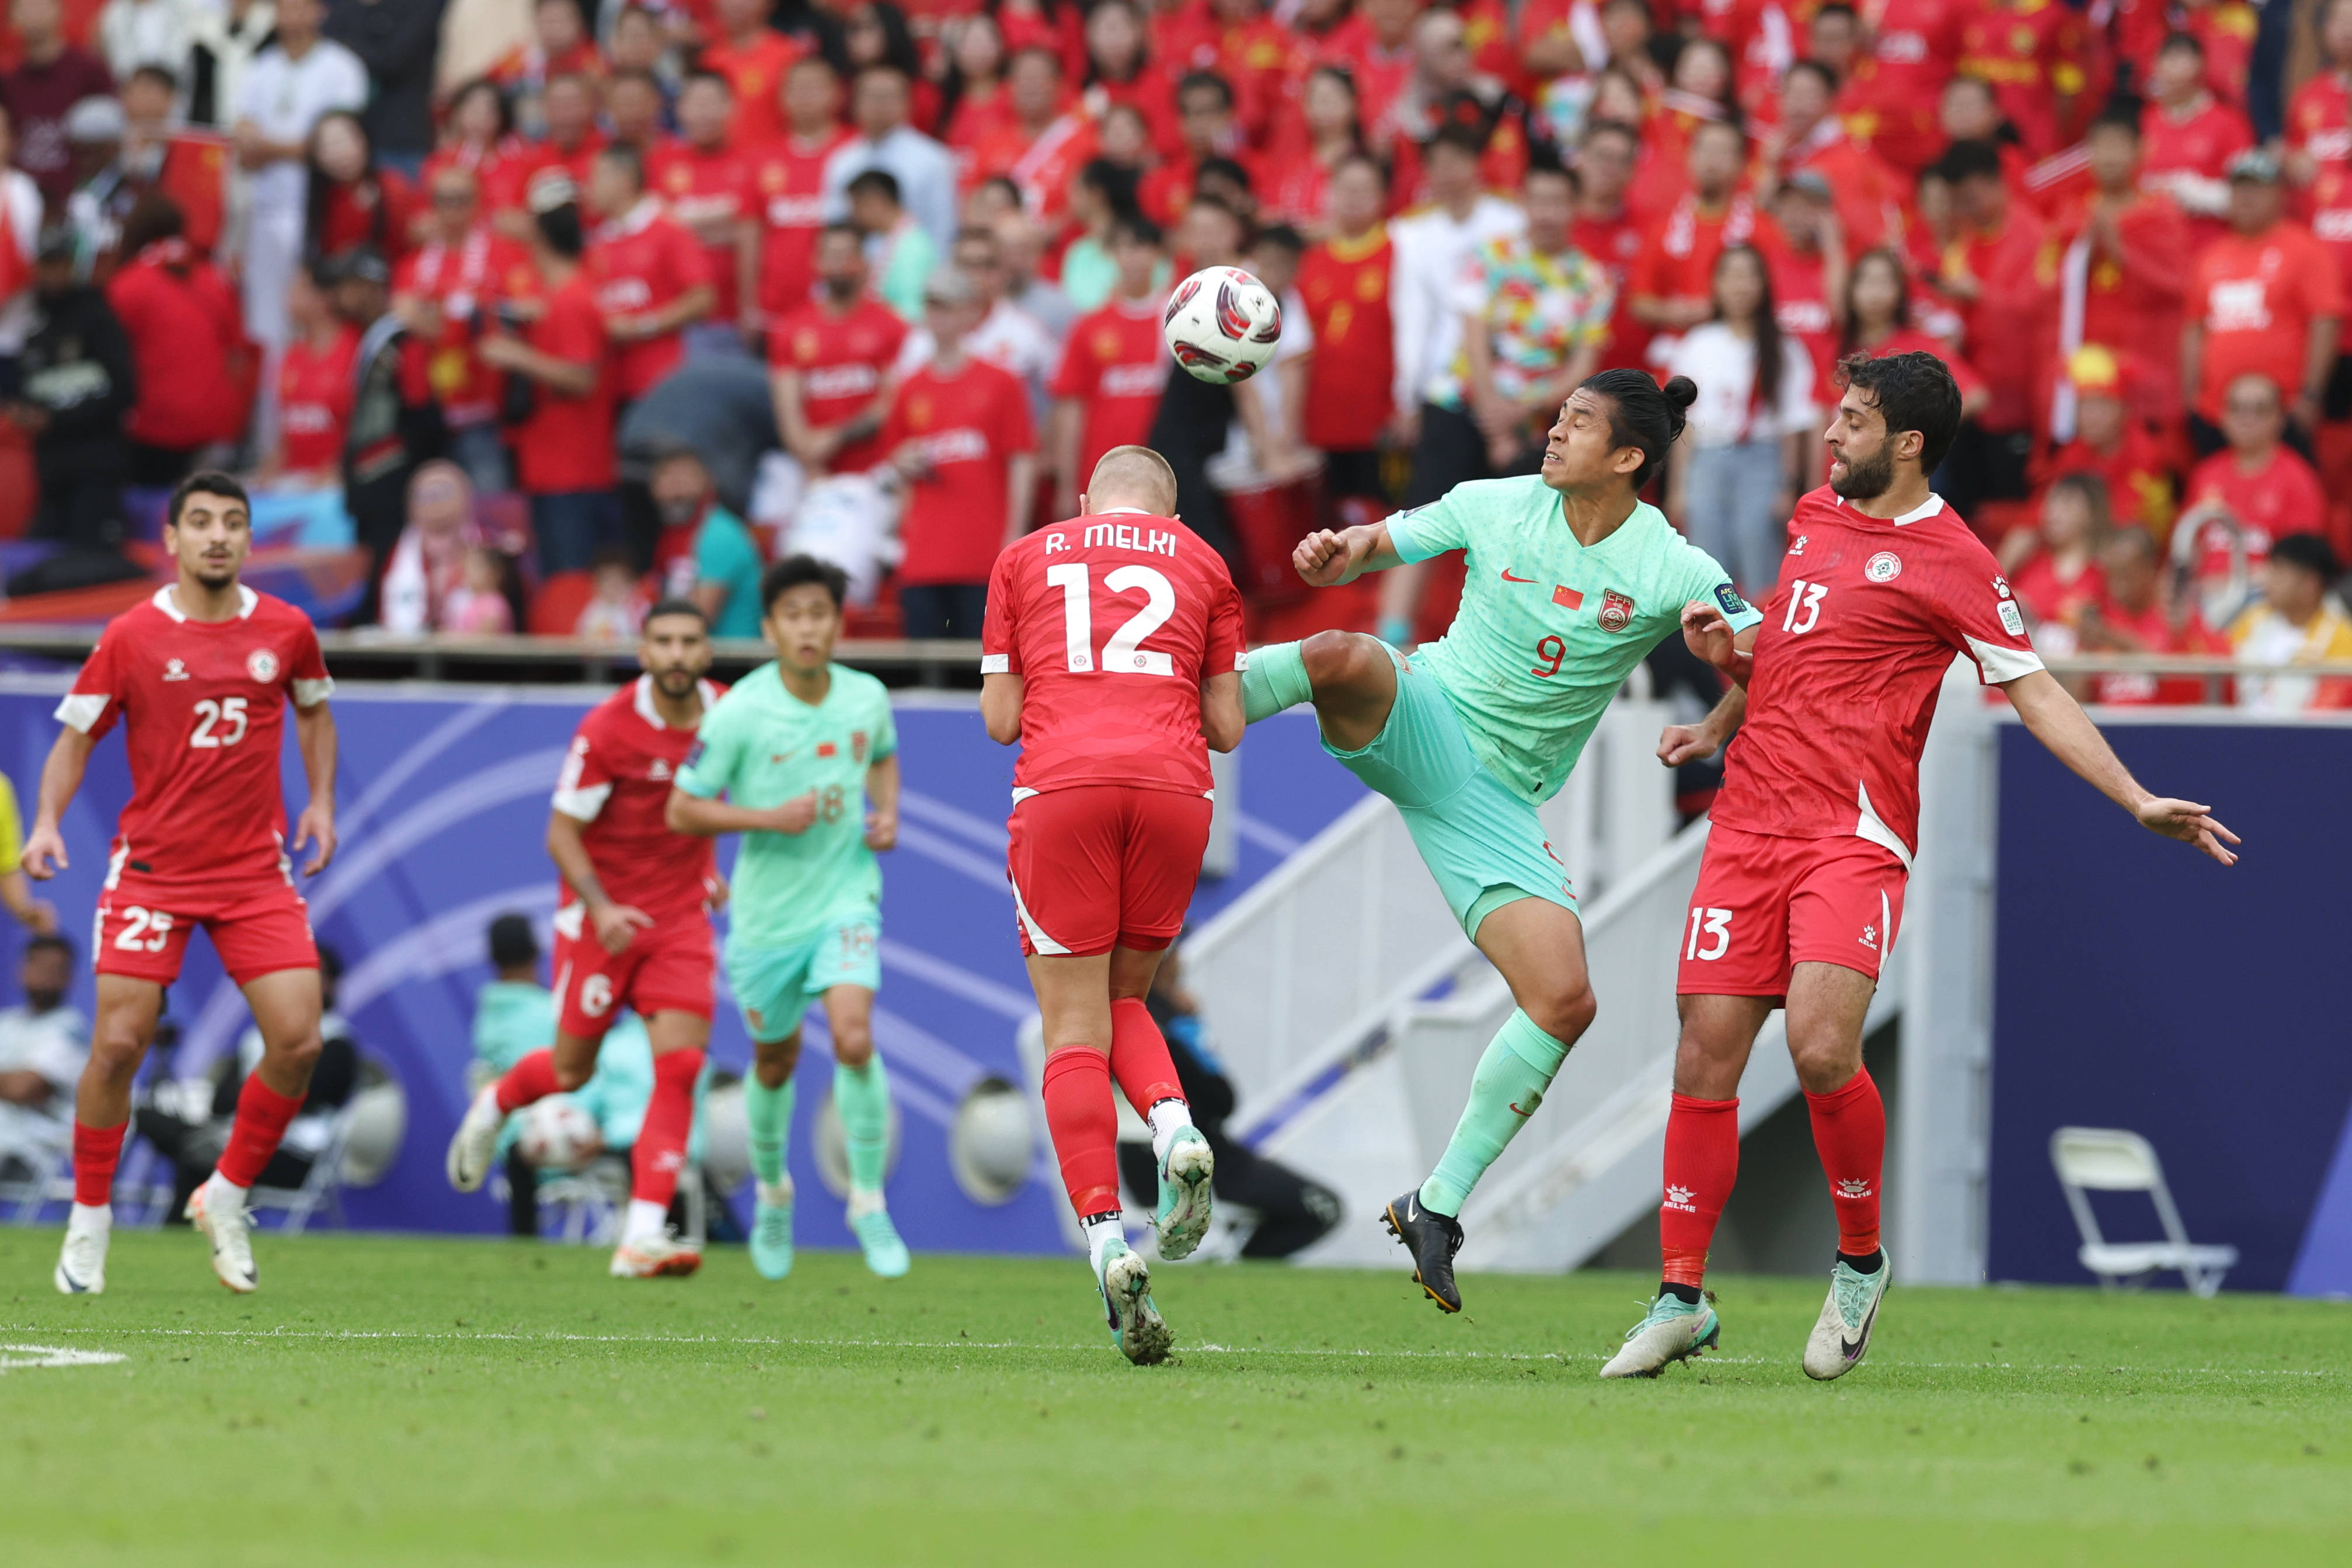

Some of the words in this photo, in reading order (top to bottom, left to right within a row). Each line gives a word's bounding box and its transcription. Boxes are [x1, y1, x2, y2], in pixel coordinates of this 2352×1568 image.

[1046, 532, 1071, 555] R.
[1084, 523, 1176, 557] MELKI
[1047, 562, 1175, 676] 12
[1607, 593, 1631, 606] CFA
[1782, 579, 1829, 635] 13
[2003, 612, 2019, 622] LIVE
[1531, 635, 1567, 678] 9
[190, 696, 248, 748] 25
[114, 905, 173, 953] 25
[1687, 907, 1733, 961] 13
[1858, 937, 1877, 950] KELME
[581, 973, 613, 1018] 6
[1663, 1200, 1696, 1213] KELME
[1837, 1189, 1872, 1198] KELME
